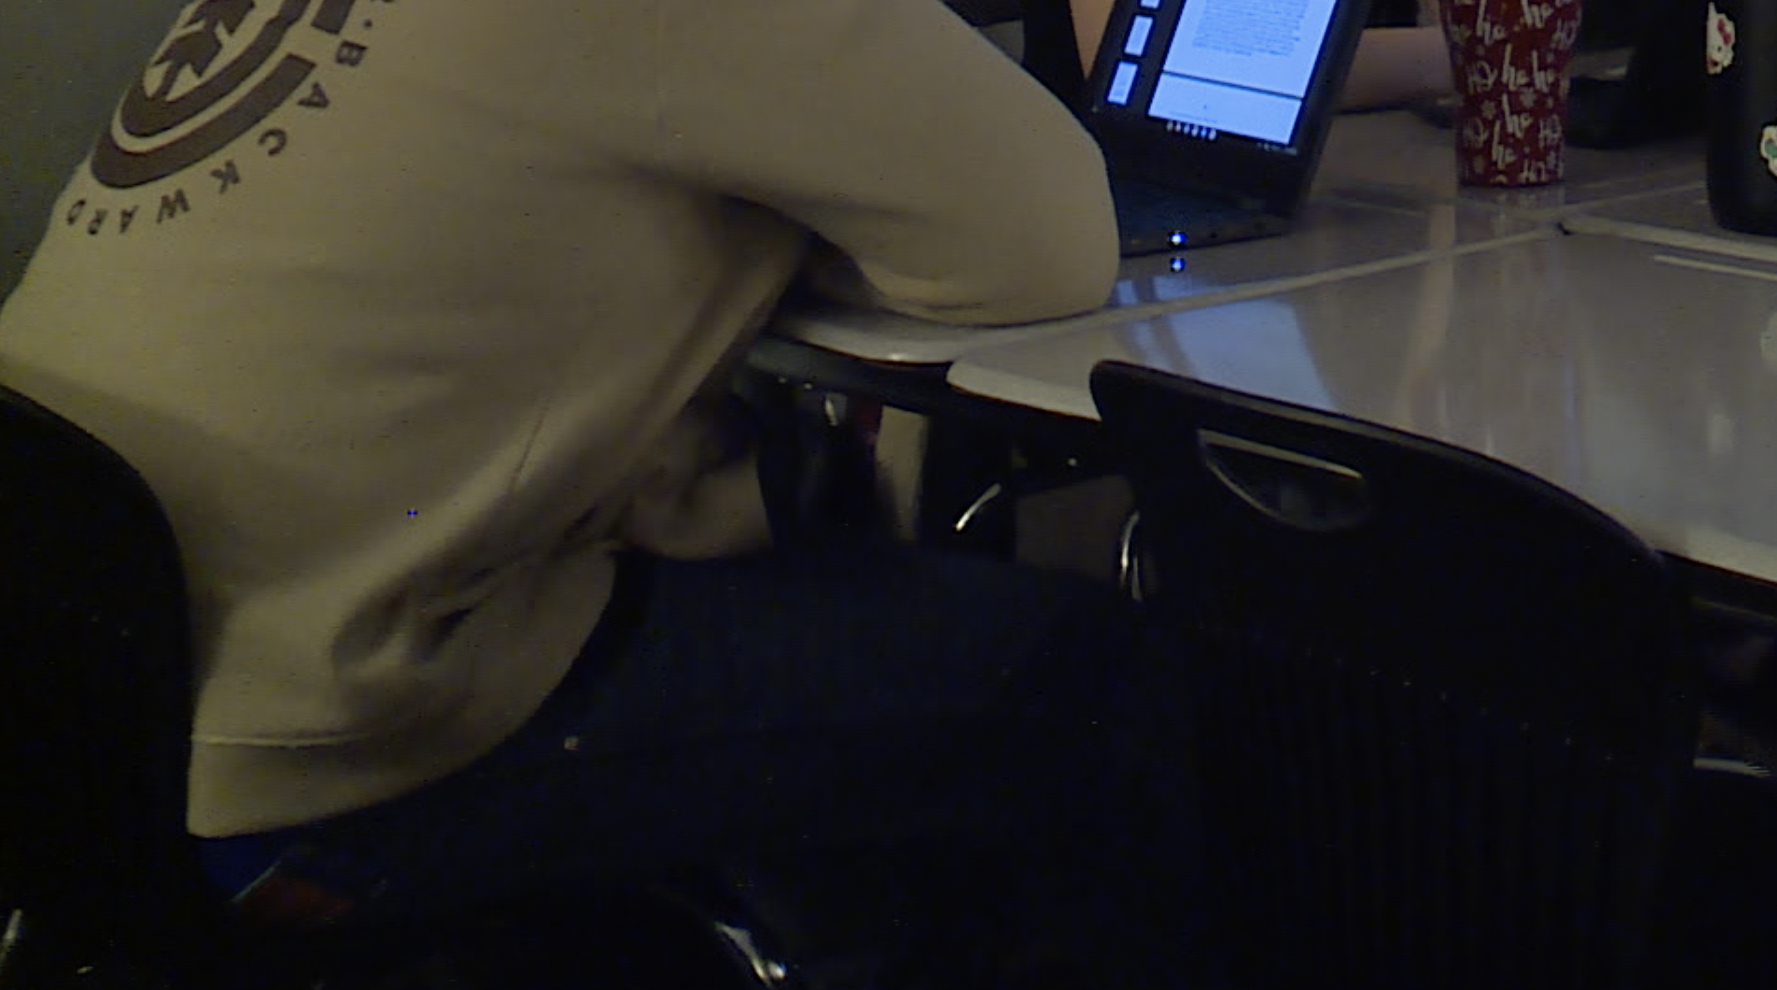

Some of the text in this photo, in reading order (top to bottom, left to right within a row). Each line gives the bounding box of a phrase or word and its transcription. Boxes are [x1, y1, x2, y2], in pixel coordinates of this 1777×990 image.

[1502, 44, 1529, 91] ho
[1532, 50, 1555, 93] ho
[1502, 93, 1533, 139] ho
[1492, 120, 1516, 170] ho
